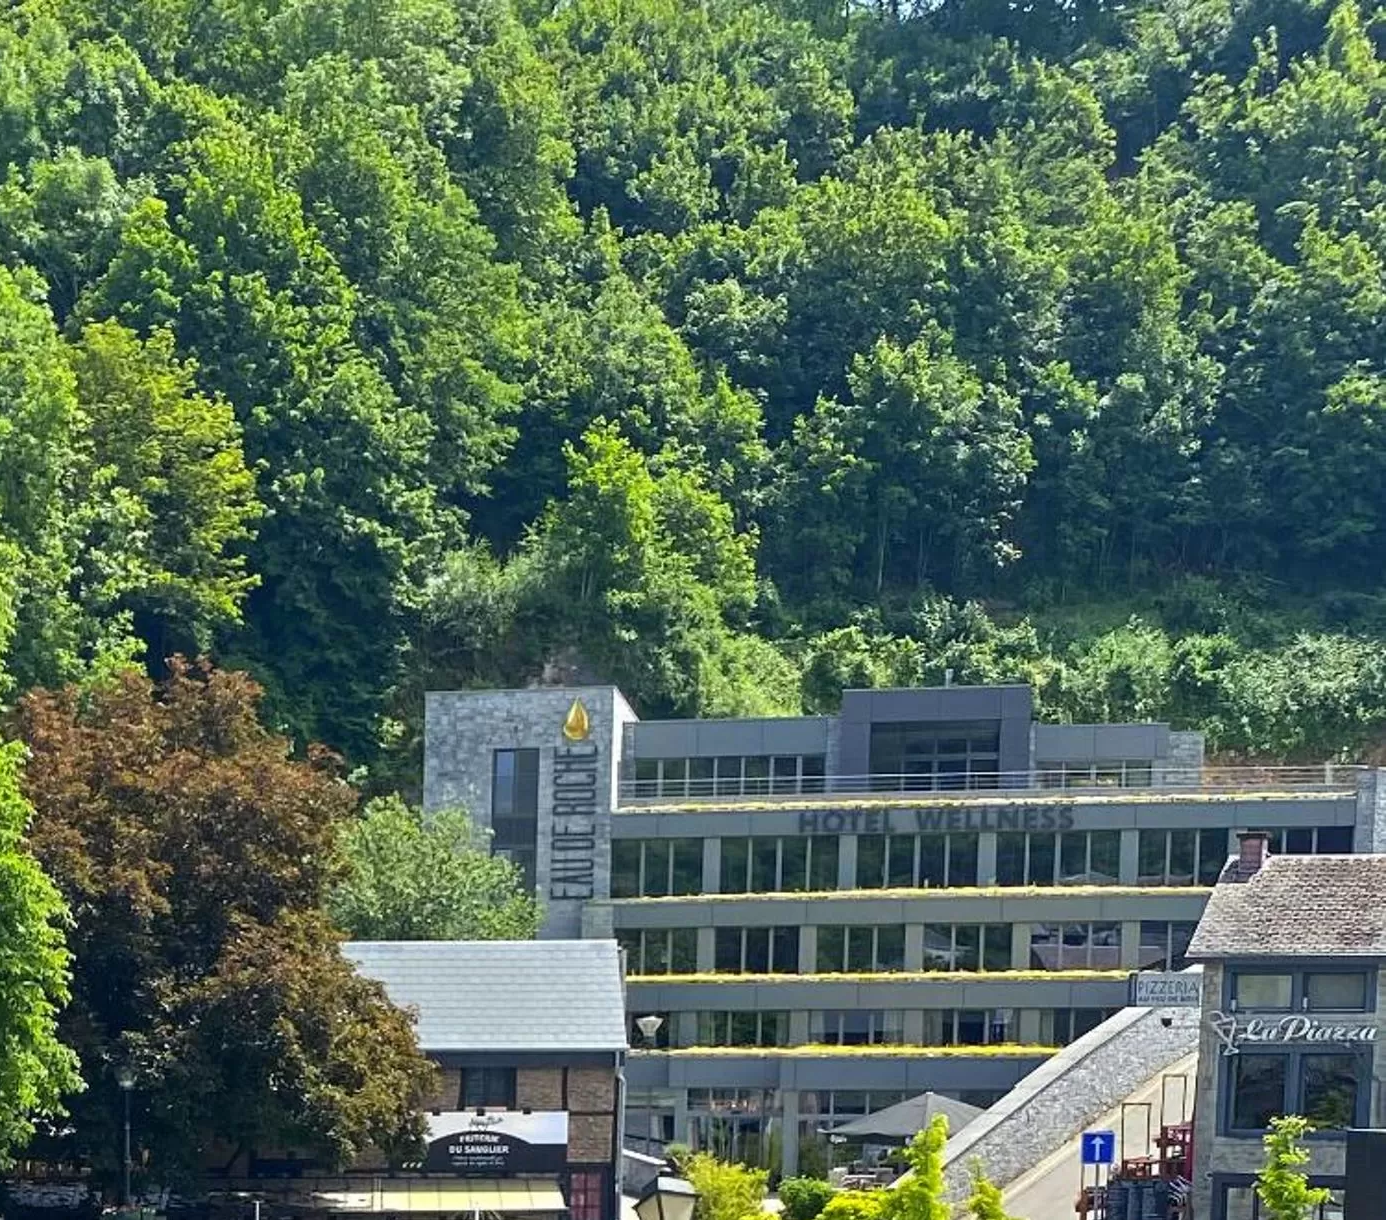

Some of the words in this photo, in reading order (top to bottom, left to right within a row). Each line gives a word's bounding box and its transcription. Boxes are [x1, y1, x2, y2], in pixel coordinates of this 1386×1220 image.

[553, 745, 598, 816] ROCHE
[798, 808, 896, 833] HOTEL
[915, 801, 1075, 831] WELLNESS
[551, 824, 596, 850] DE
[550, 858, 594, 900] EAU
[1138, 980, 1199, 994] PIZZERIA
[1238, 1018, 1279, 1041] La
[1279, 1015, 1379, 1042] Piazza
[449, 1145, 463, 1153] DU
[464, 1145, 510, 1153] SANGLIER
